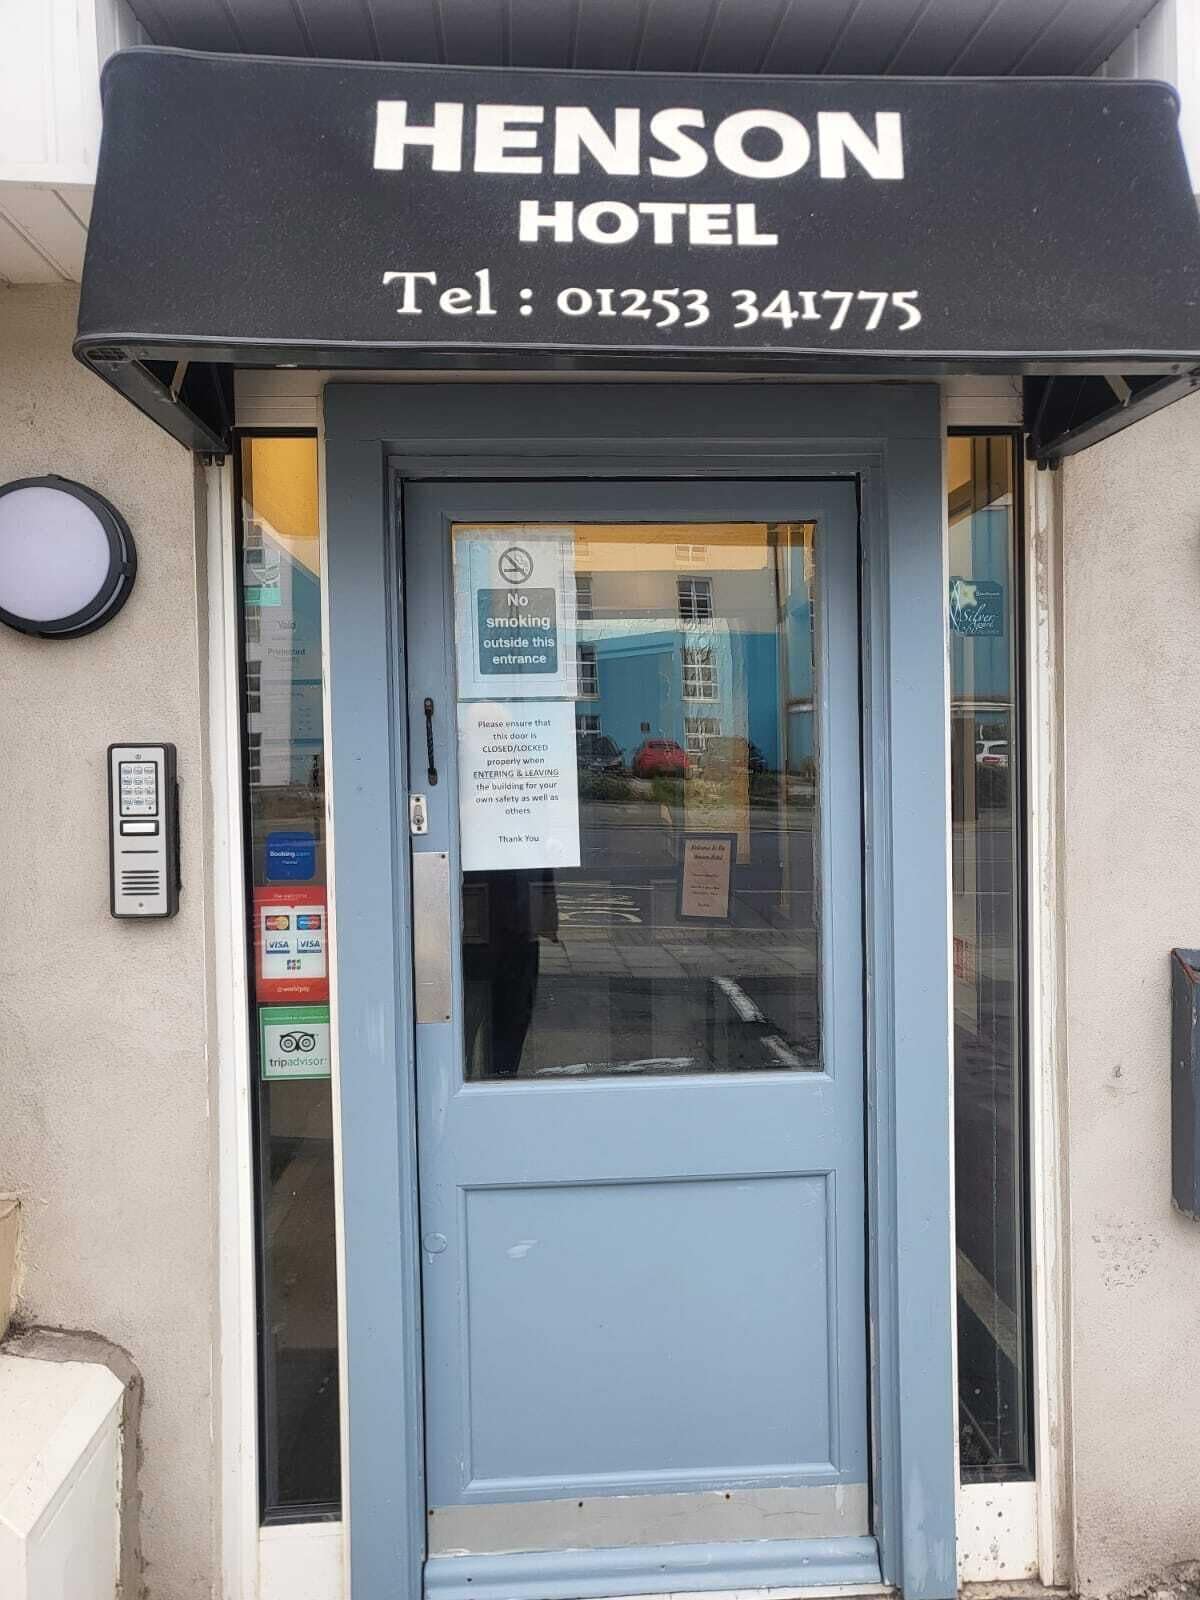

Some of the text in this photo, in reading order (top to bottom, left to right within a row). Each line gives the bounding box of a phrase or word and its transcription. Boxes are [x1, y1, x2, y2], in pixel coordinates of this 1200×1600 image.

[373, 100, 905, 180] HENSON
[518, 200, 779, 246] HOTEL
[382, 268, 497, 316] Tel
[556, 287, 711, 329] 01253
[732, 289, 923, 332] 341775
[507, 593, 529, 606] No
[486, 614, 551, 630] smoking
[483, 636, 555, 648] outside this
[492, 653, 547, 665] entrance
[478, 719, 551, 728] Please ensure that
[493, 732, 508, 741] this
[510, 732, 528, 740] door
[482, 744, 549, 753] CLOSED/LOCKED
[487, 757, 545, 766] properly when
[473, 769, 514, 779] ENTERING
[524, 768, 560, 778] LEAVING
[476, 781, 558, 791] the building for your
[475, 796, 493, 804] own
[495, 794, 519, 803] safety
[531, 793, 548, 802] well
[505, 807, 531, 815] others
[498, 834, 540, 843] Thank You
[269, 940, 321, 949] VISA VISA
[269, 1057, 326, 1068] tripadvisor
